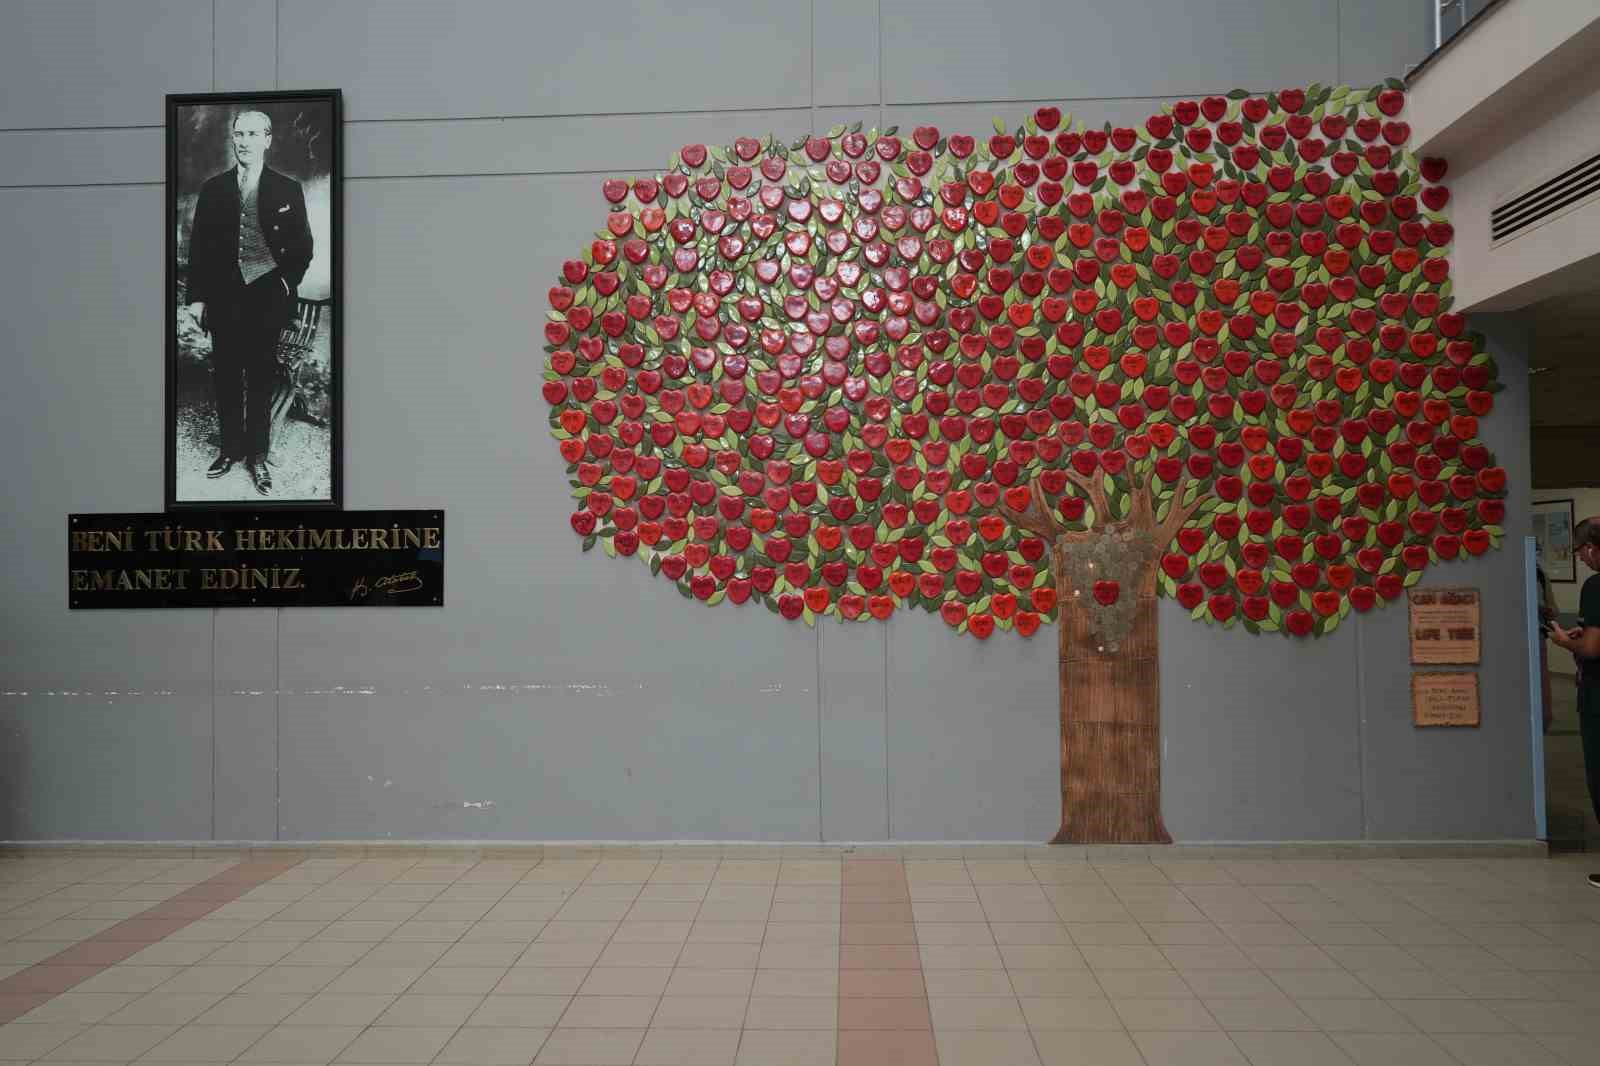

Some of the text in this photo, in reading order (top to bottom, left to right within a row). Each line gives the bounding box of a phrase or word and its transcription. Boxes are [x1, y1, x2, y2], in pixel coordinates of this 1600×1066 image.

[71, 523, 440, 552] BENİ TÜRK HEKİMLERİNE
[71, 563, 306, 591] EMANET EDİNİZ.
